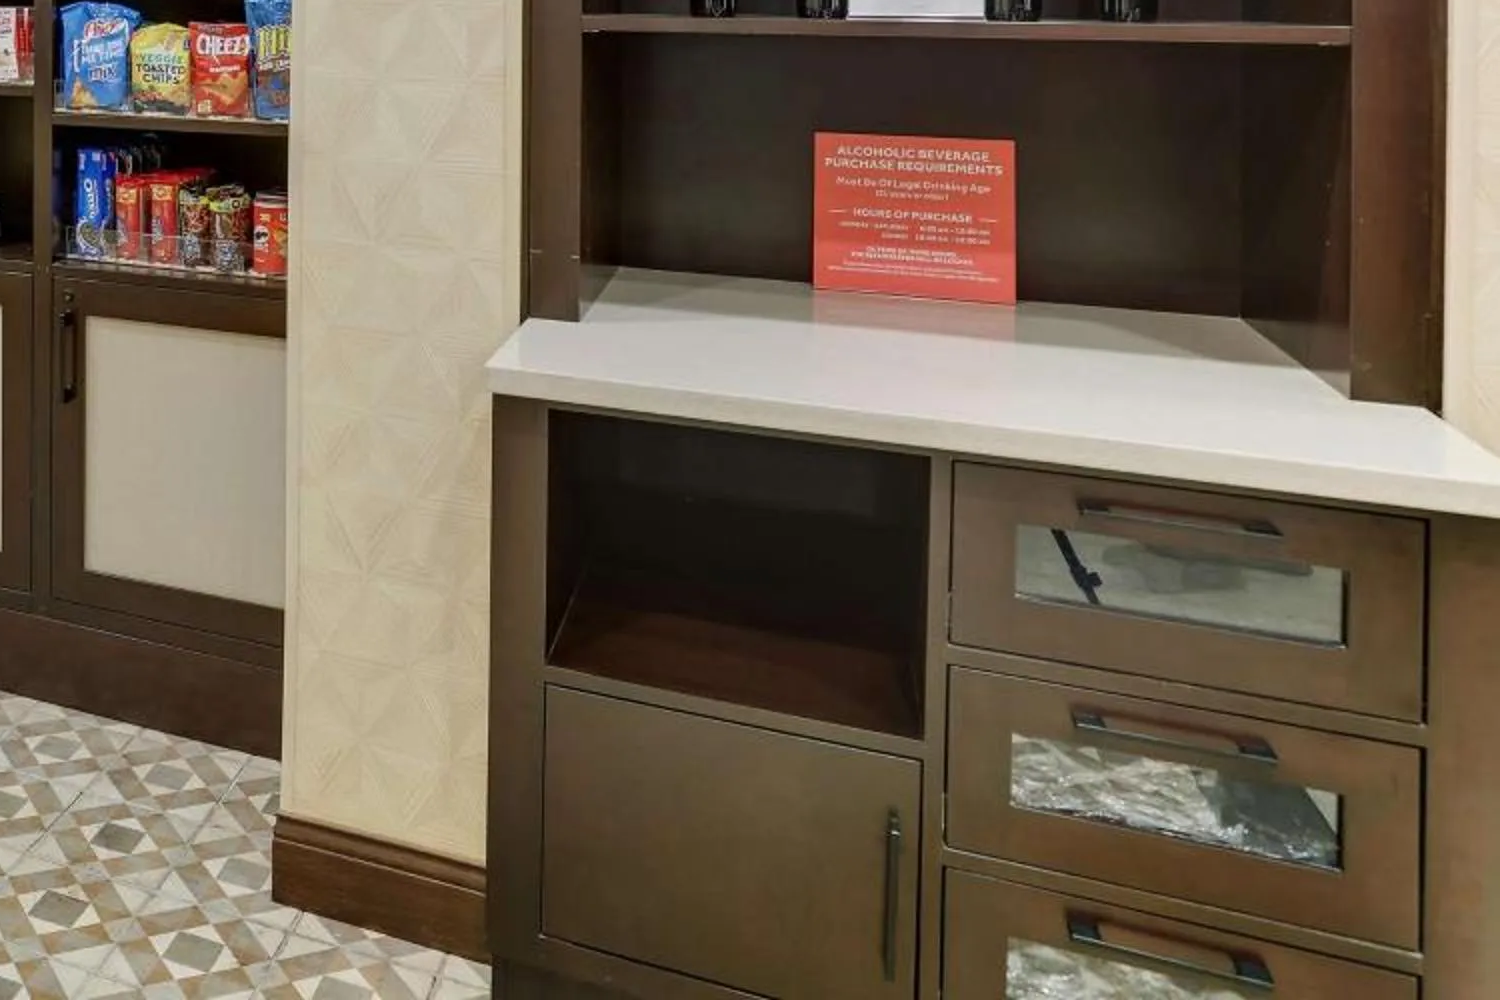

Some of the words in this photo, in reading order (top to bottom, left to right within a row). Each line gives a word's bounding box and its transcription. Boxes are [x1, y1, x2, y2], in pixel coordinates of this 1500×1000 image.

[142, 74, 181, 85] CHIPS
[837, 146, 916, 159] ALCOHOLIC
[917, 149, 990, 162] BEVERAGE
[824, 157, 895, 171] PURCHASE
[897, 161, 1003, 176] REQUIREMENTS
[853, 207, 892, 219] HOURS
[894, 210, 910, 219] OF
[911, 211, 973, 224] PURCHASE
